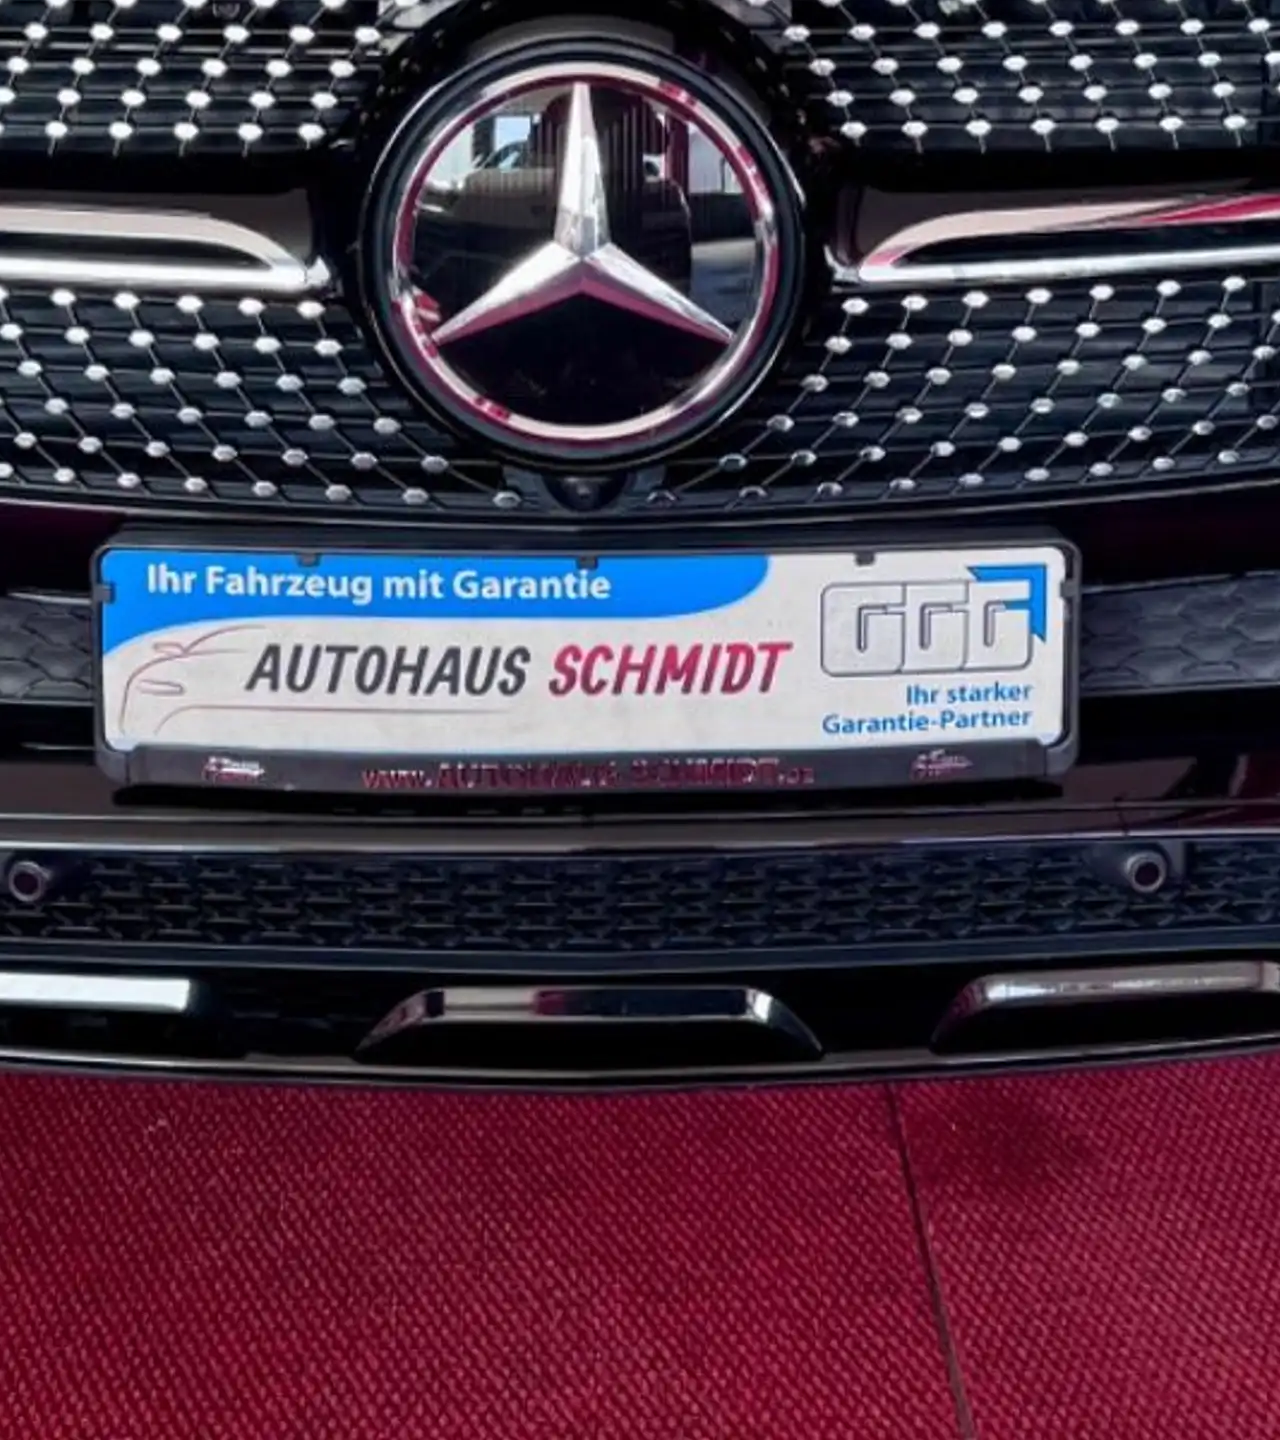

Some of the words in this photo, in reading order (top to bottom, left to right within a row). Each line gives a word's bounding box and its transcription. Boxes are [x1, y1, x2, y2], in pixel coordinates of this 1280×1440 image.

[147, 563, 197, 593] Ihr
[205, 565, 373, 606] Fahrzeug
[384, 568, 445, 599] mit
[453, 569, 612, 599] Garantie
[245, 643, 531, 696] AUTOHAUS
[548, 641, 793, 696] SCHMIDT
[906, 685, 940, 705] Ihr
[947, 682, 1032, 703] starker
[822, 709, 1032, 734] Garantie-Partner
